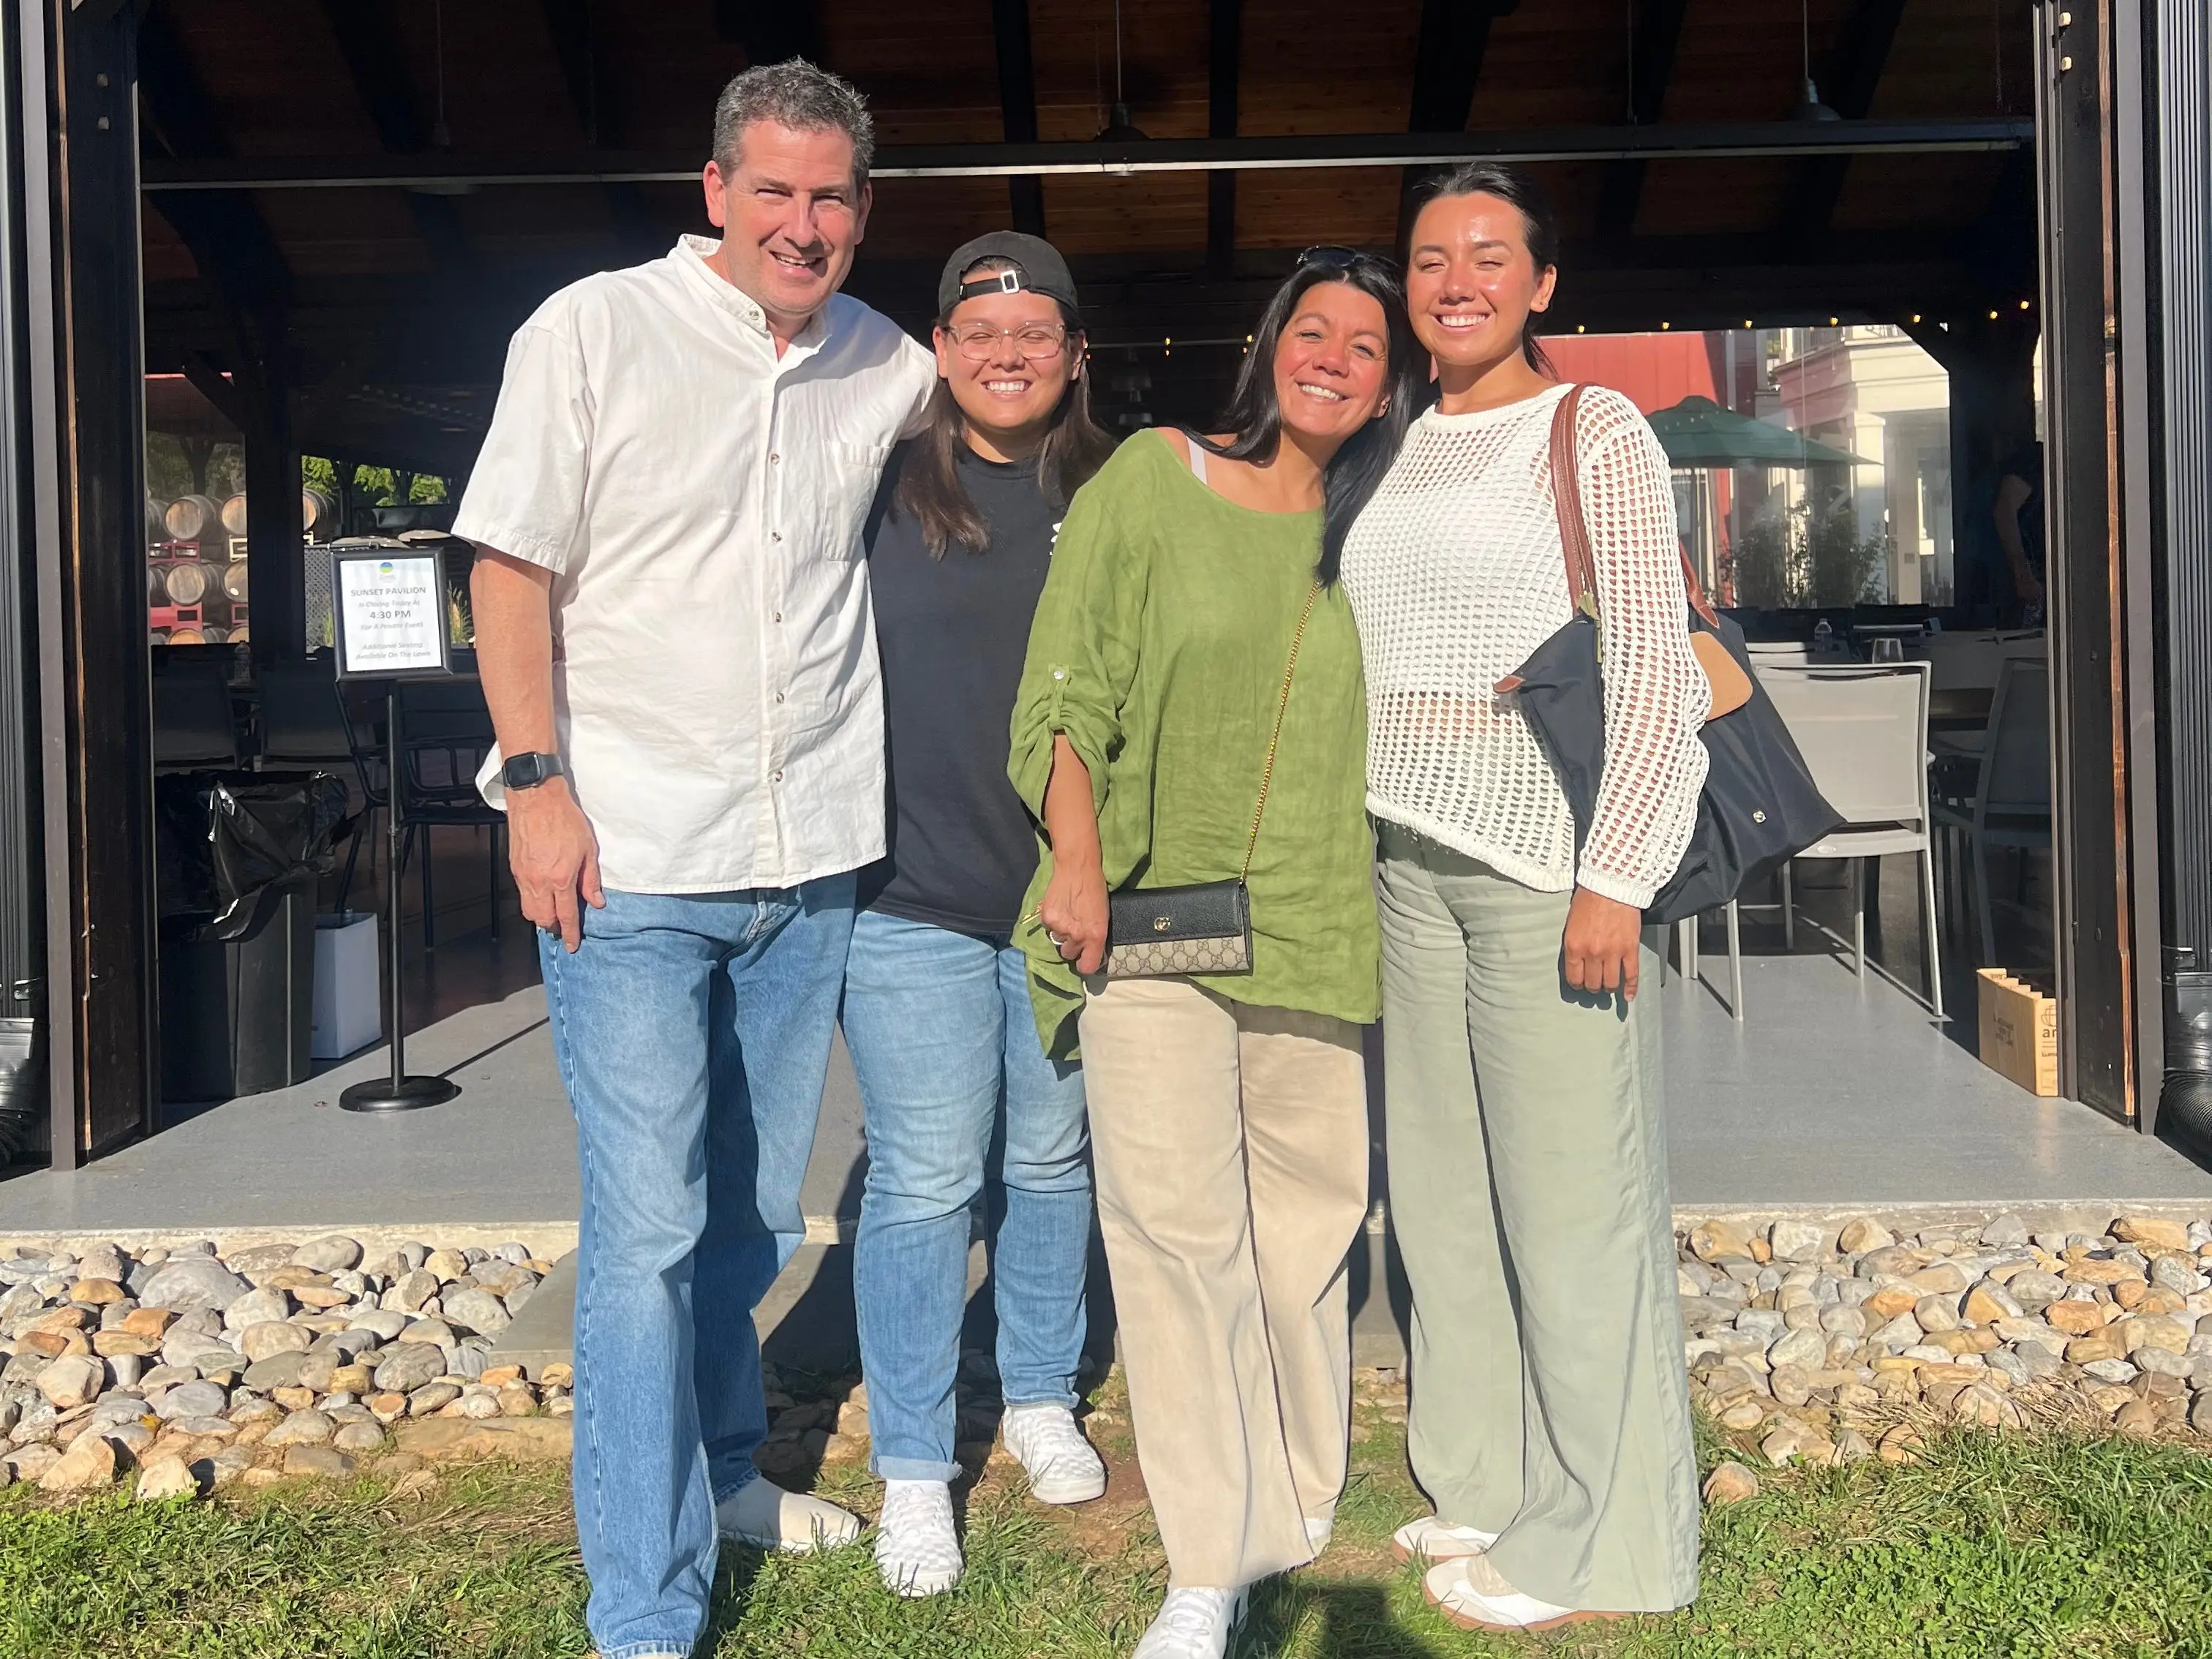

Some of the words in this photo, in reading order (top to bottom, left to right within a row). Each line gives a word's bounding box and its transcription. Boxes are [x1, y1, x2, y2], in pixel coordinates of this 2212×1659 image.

[369, 611, 391, 619] 4:30
[394, 610, 411, 618] PM
[356, 652, 386, 660] Available
